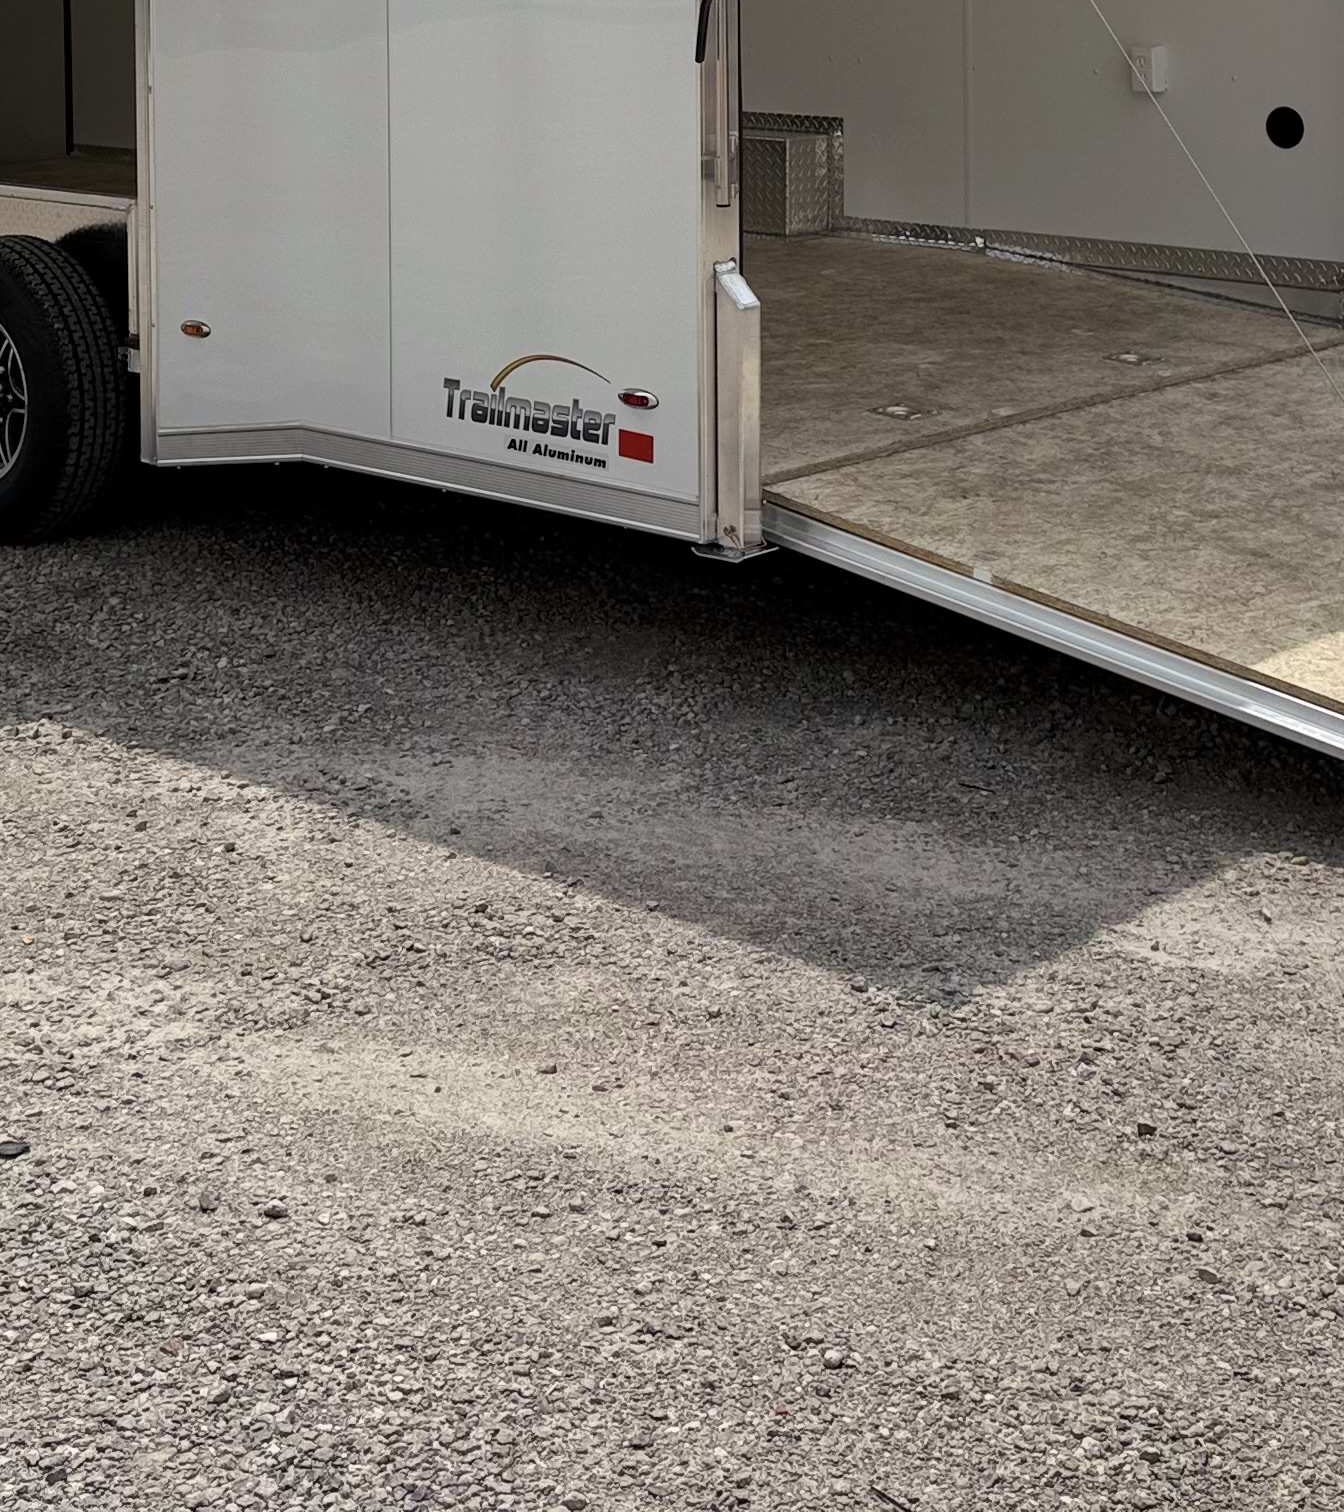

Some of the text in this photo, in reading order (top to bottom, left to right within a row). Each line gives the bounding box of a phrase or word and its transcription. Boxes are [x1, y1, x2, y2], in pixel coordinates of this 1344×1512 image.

[443, 377, 617, 445] Trailmaster
[507, 438, 607, 469] All Aluminum
